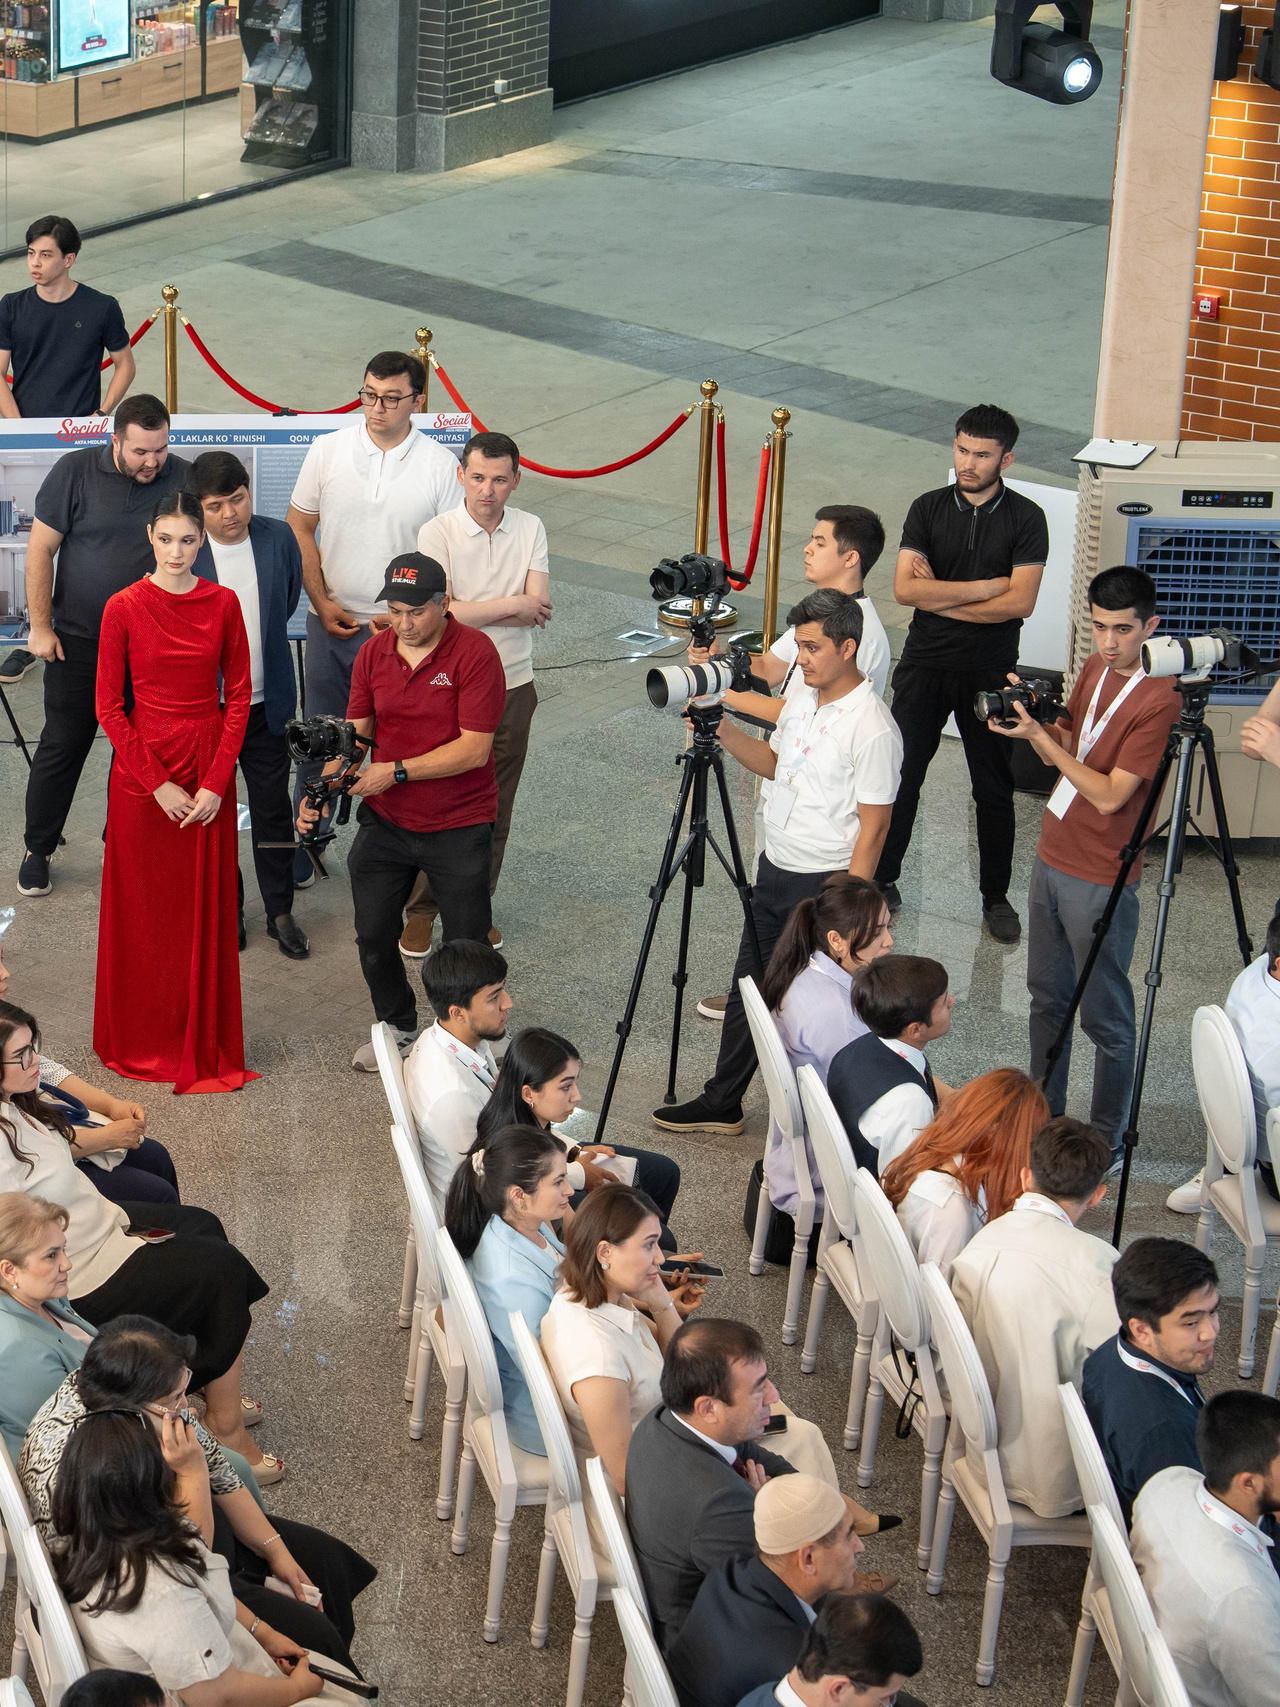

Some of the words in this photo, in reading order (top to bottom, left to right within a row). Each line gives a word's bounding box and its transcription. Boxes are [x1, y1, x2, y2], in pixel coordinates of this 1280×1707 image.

[434, 413, 470, 430] Social
[57, 418, 109, 442] Social
[289, 435, 310, 443] QON
[392, 567, 419, 580] LIVE
